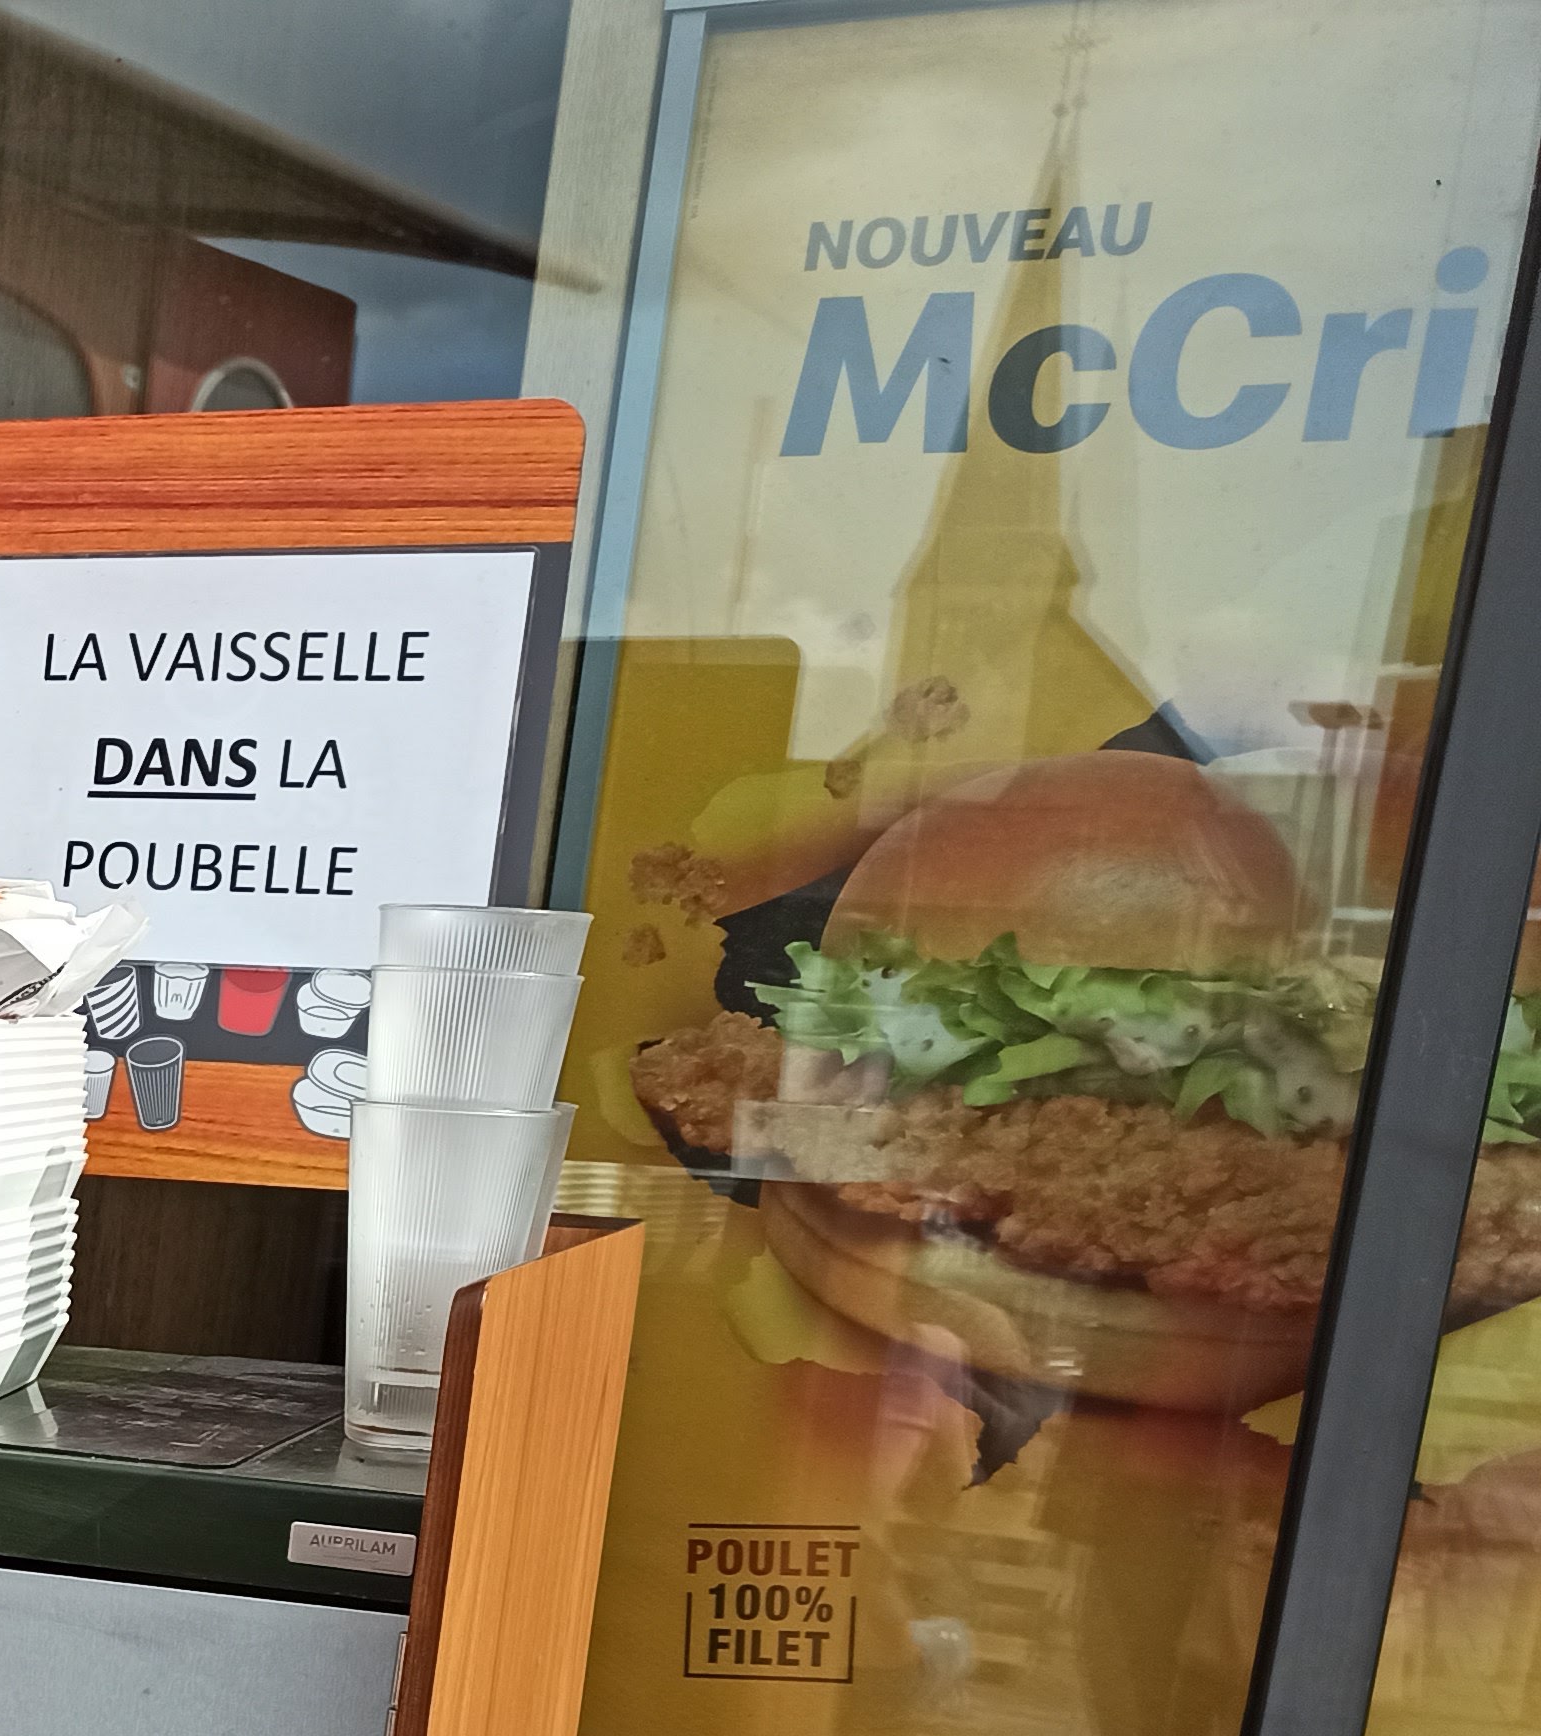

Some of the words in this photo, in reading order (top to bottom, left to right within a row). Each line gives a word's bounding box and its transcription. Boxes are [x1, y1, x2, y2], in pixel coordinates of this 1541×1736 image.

[804, 203, 1152, 272] NOUVEAU
[779, 245, 1490, 457] McCri
[43, 632, 107, 682] LA
[128, 631, 430, 683] VAISSELLE
[92, 737, 259, 791] DANS
[279, 738, 348, 790] LA
[62, 840, 359, 897] POUBELLE
[686, 1538, 861, 1579] POULET
[708, 1583, 834, 1624] 100%
[707, 1628, 831, 1668] FILET
